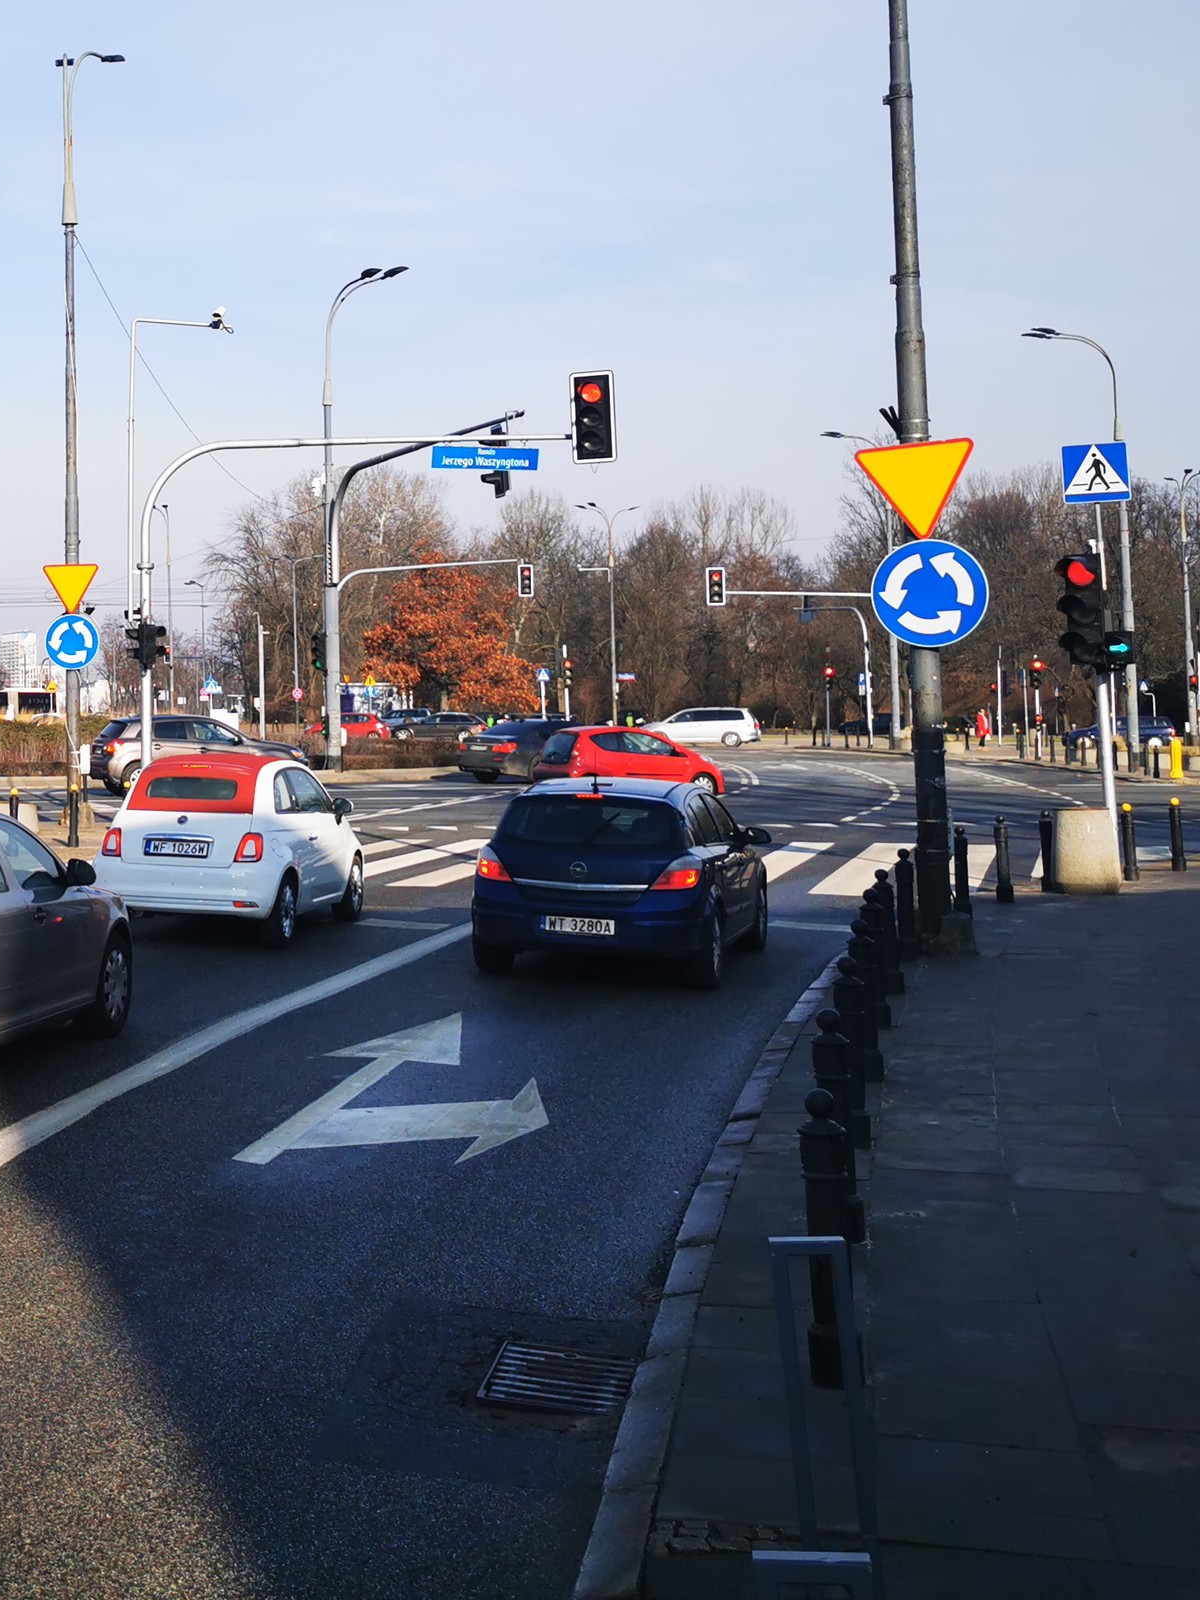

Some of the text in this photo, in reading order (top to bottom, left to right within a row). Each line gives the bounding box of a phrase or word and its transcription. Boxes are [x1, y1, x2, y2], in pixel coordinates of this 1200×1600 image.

[441, 455, 529, 469] Jerzego Waszyngtona
[152, 842, 205, 854] WF 1026W
[548, 917, 566, 930] WT
[570, 918, 612, 934] 3280A
